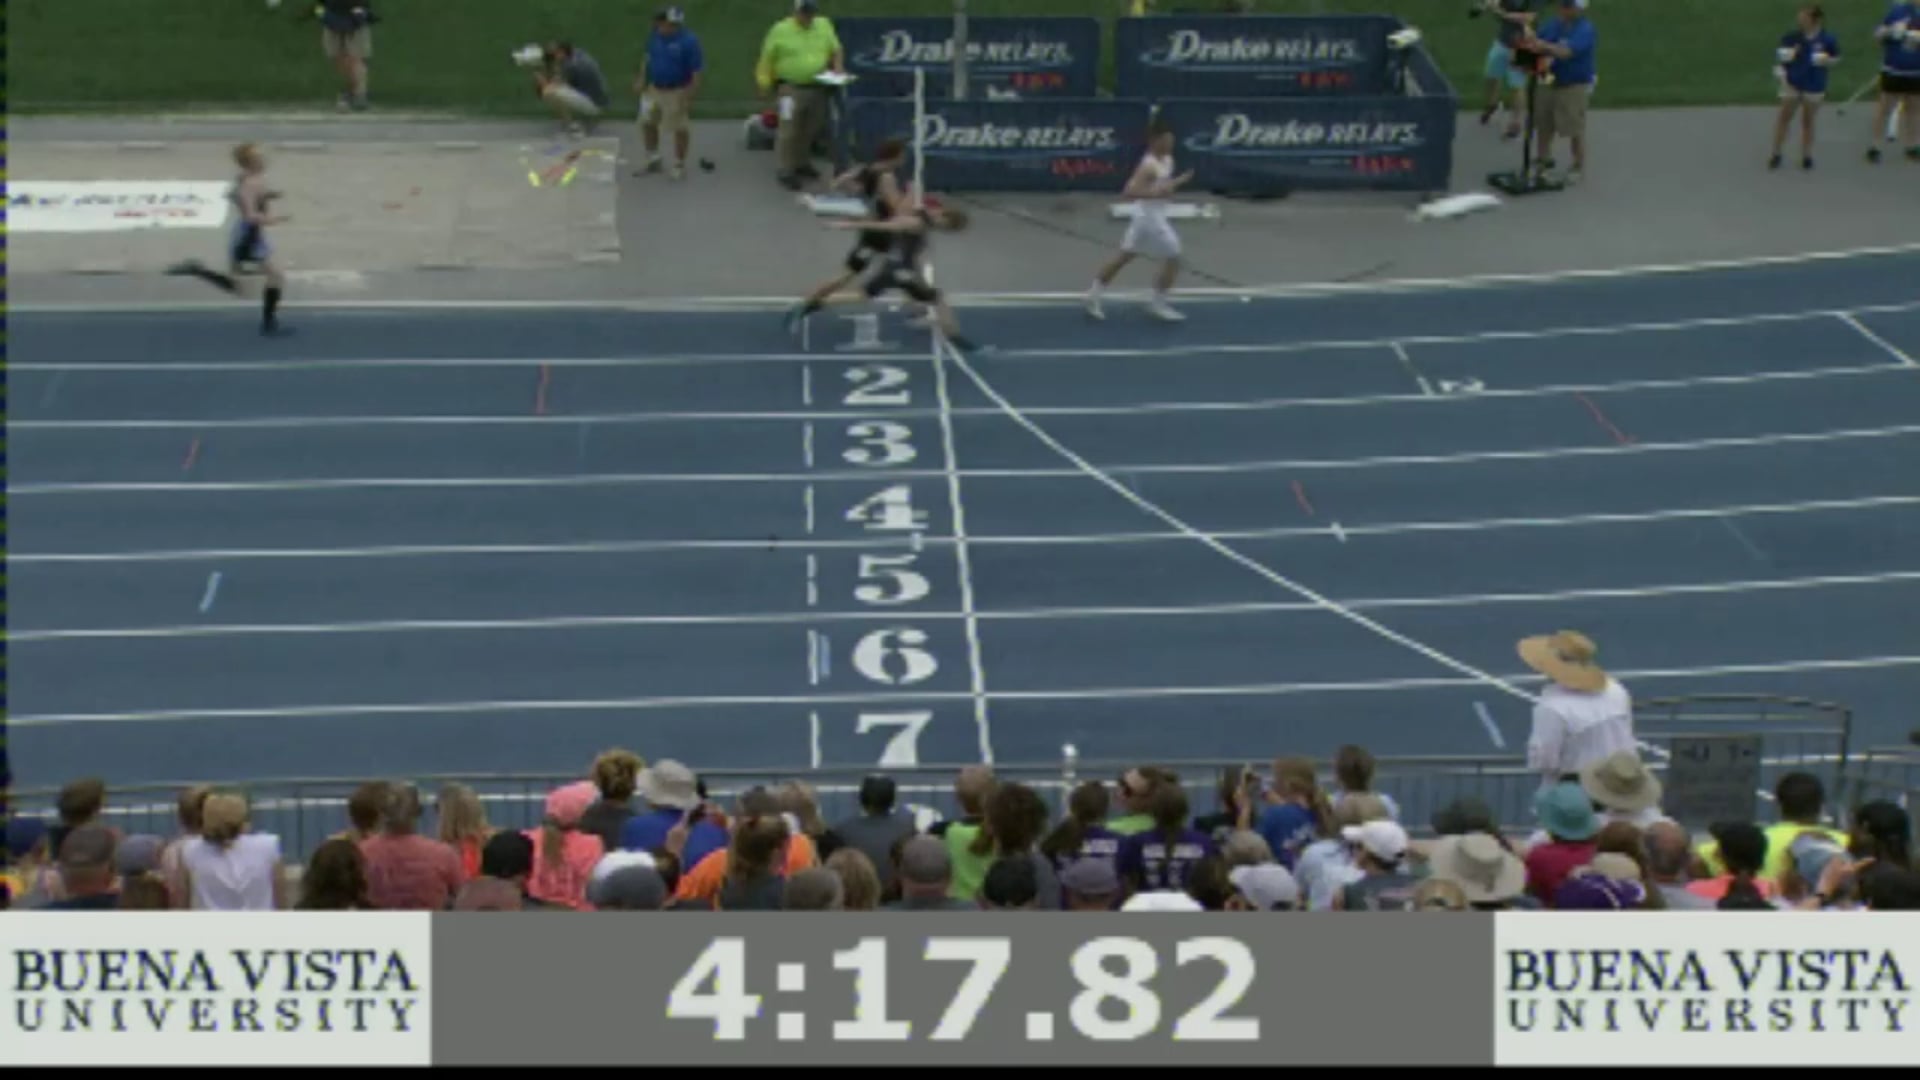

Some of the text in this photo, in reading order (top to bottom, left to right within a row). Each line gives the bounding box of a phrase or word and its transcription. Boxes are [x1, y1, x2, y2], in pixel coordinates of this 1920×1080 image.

[1167, 30, 1270, 62] Drake
[916, 113, 1115, 147] Drake RELAYS
[1214, 113, 1418, 147] Drake RELAYS
[843, 365, 911, 405] 2
[843, 421, 917, 465] 3
[846, 486, 929, 530] 4
[853, 554, 930, 605] 5
[852, 626, 938, 685] 6
[855, 711, 933, 768] 7
